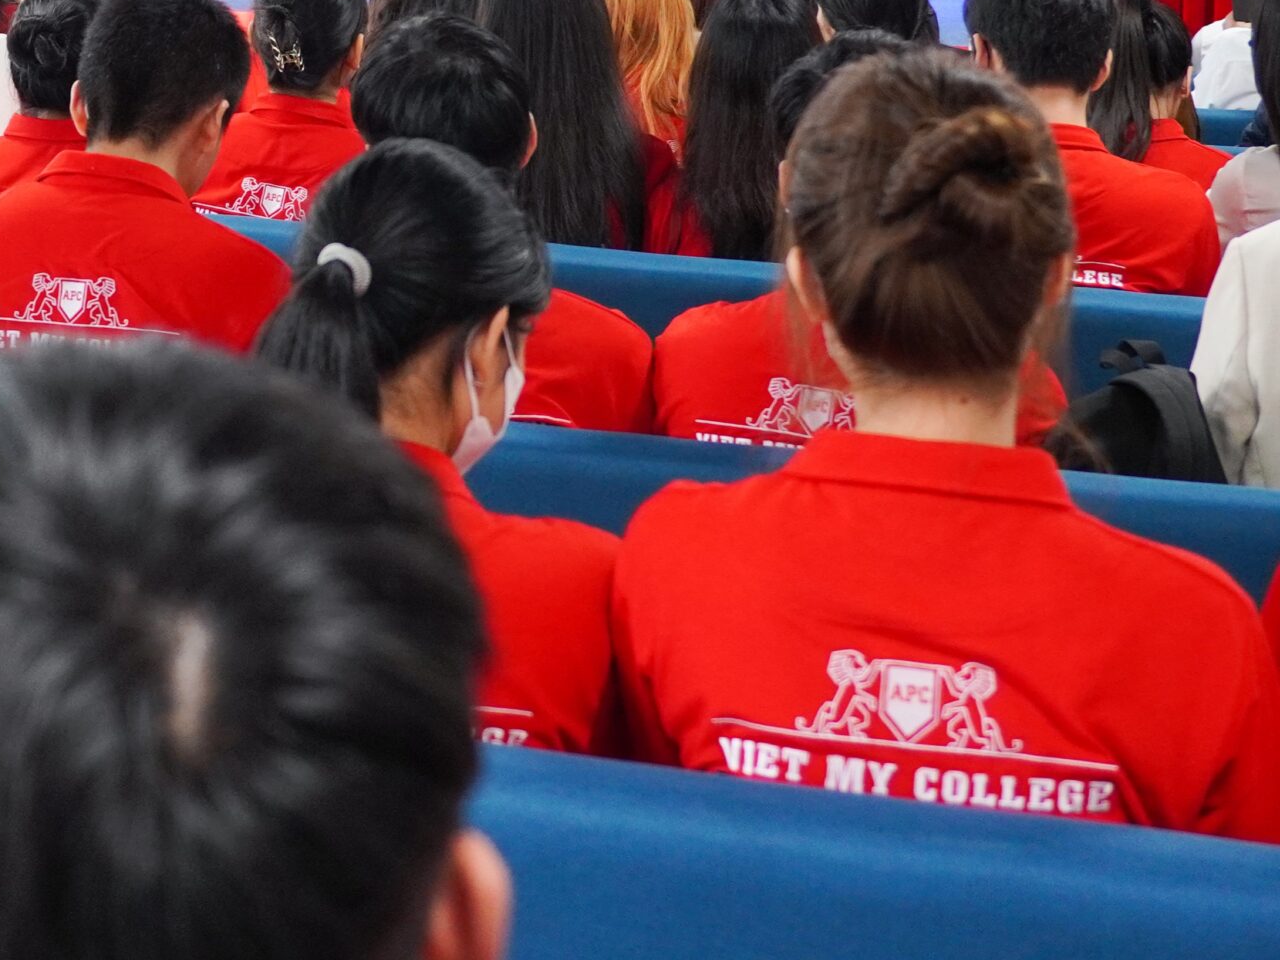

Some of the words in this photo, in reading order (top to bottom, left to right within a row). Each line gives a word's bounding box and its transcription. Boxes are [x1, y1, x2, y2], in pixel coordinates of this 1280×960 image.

[265, 193, 281, 202] APC
[1072, 270, 1124, 287] LEGE
[62, 290, 82, 301] APC
[889, 684, 930, 704] APC
[718, 737, 810, 782] VIET
[824, 755, 897, 795] MY
[913, 766, 1114, 814] COLLEGE
